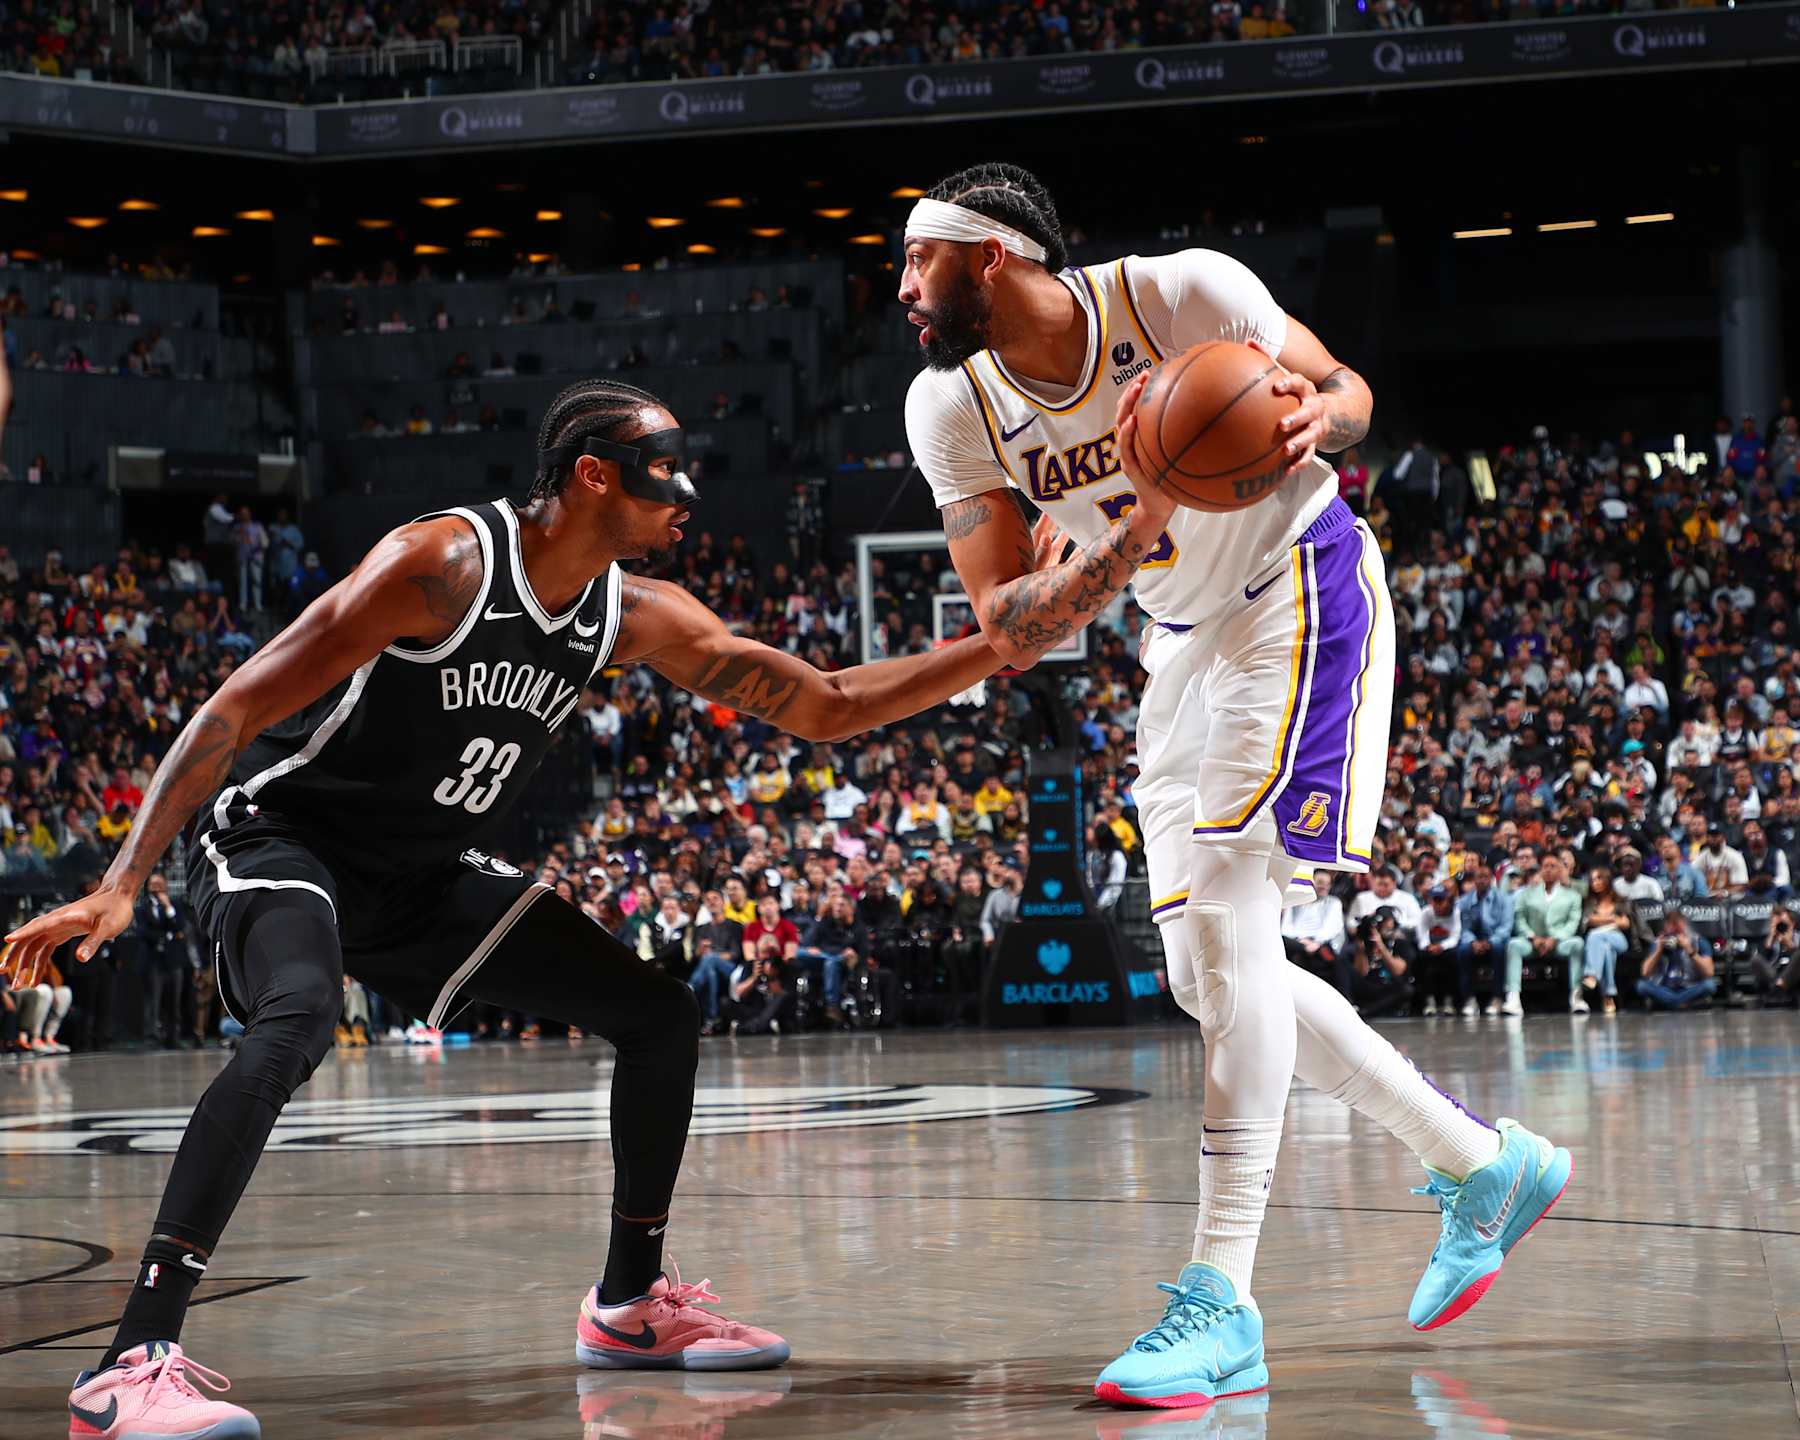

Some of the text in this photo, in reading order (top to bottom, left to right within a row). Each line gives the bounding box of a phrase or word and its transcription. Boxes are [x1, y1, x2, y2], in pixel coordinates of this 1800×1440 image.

[1613, 25, 1645, 55] Q
[1373, 41, 1404, 72] Q
[1136, 58, 1165, 89] Q
[906, 74, 935, 105] Q
[440, 107, 468, 136] Q
[660, 91, 688, 122] Q
[1112, 358, 1152, 386] bibigo
[1019, 426, 1123, 502] LAKE
[568, 639, 595, 654] Webull
[433, 736, 521, 814] 33
[1023, 903, 1084, 916] BARCLAYS
[1003, 983, 1110, 1004] BARCLAYS
